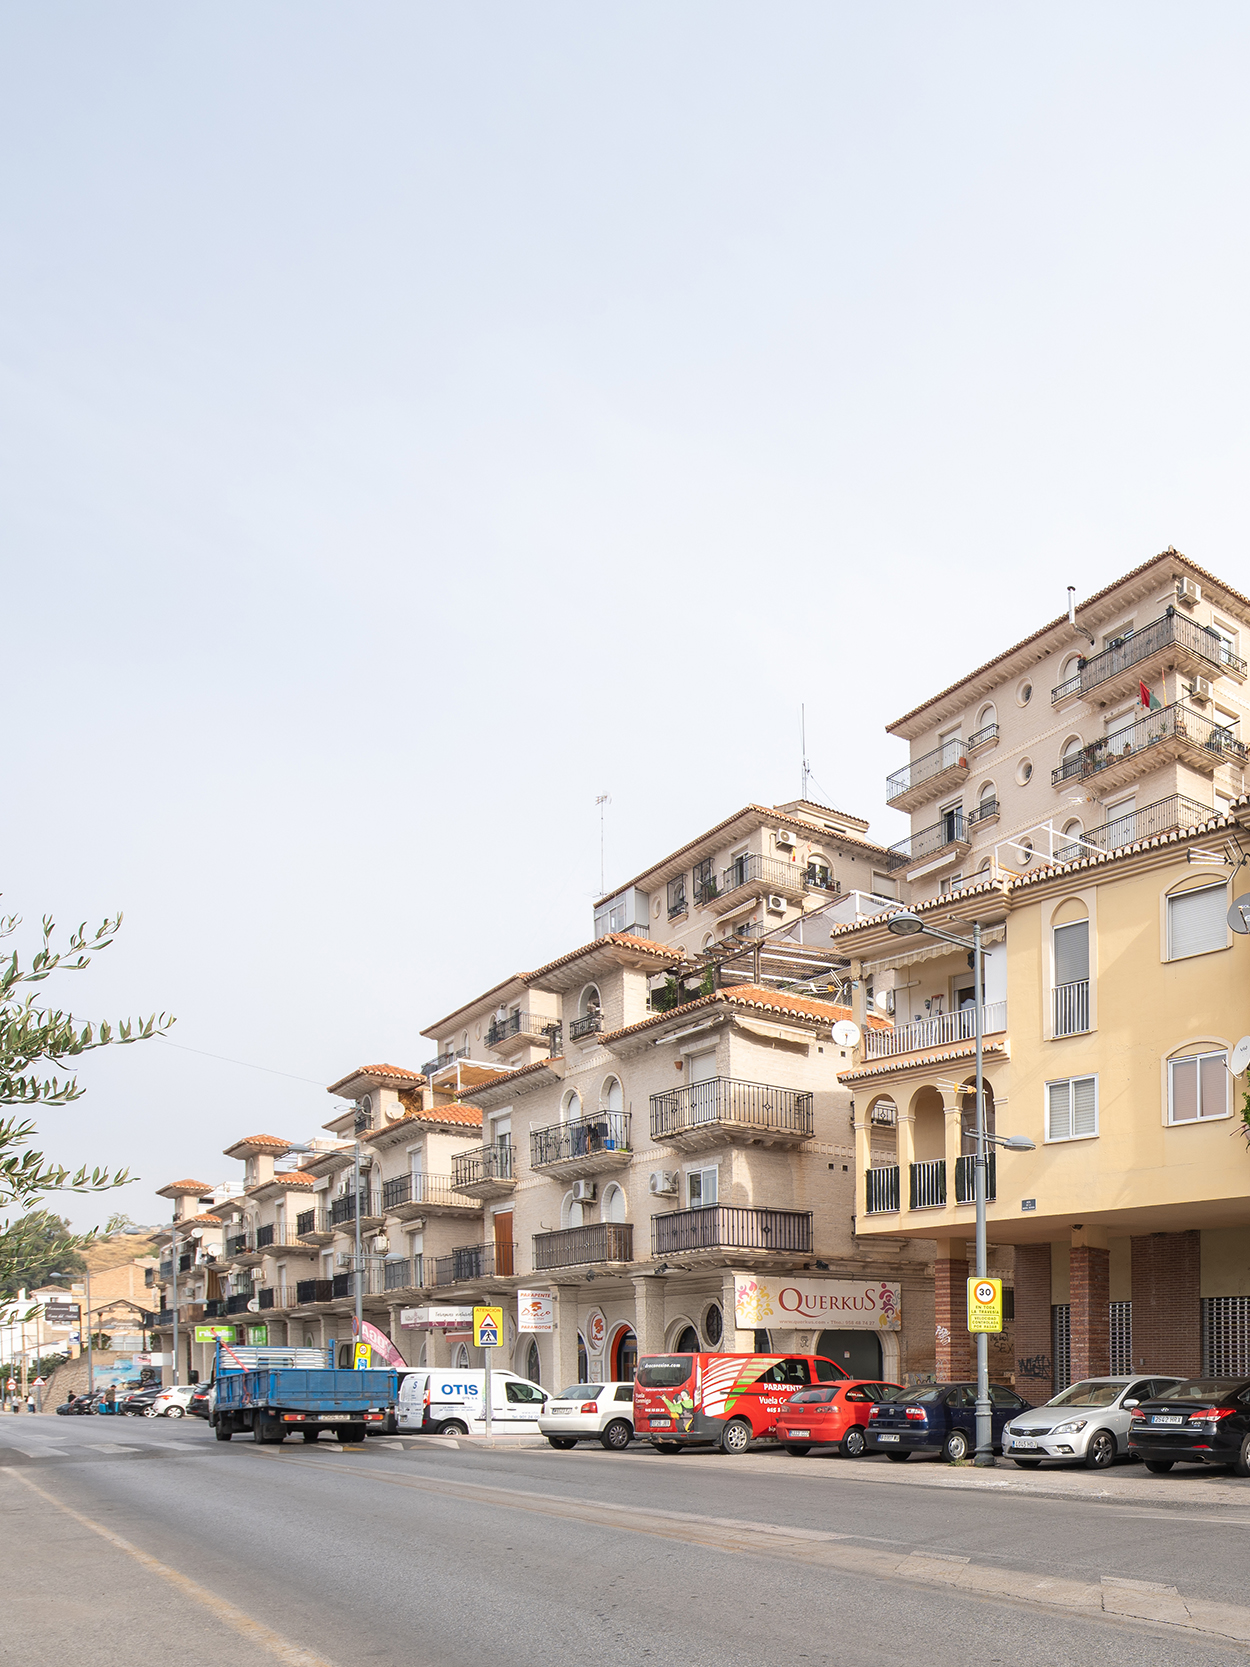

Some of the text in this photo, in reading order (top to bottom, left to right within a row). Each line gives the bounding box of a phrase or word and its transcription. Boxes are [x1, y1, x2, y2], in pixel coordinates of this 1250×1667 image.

[979, 1288, 992, 1296] 30
[441, 1384, 479, 1396] OTIS
[759, 1396, 777, 1405] Vuela
